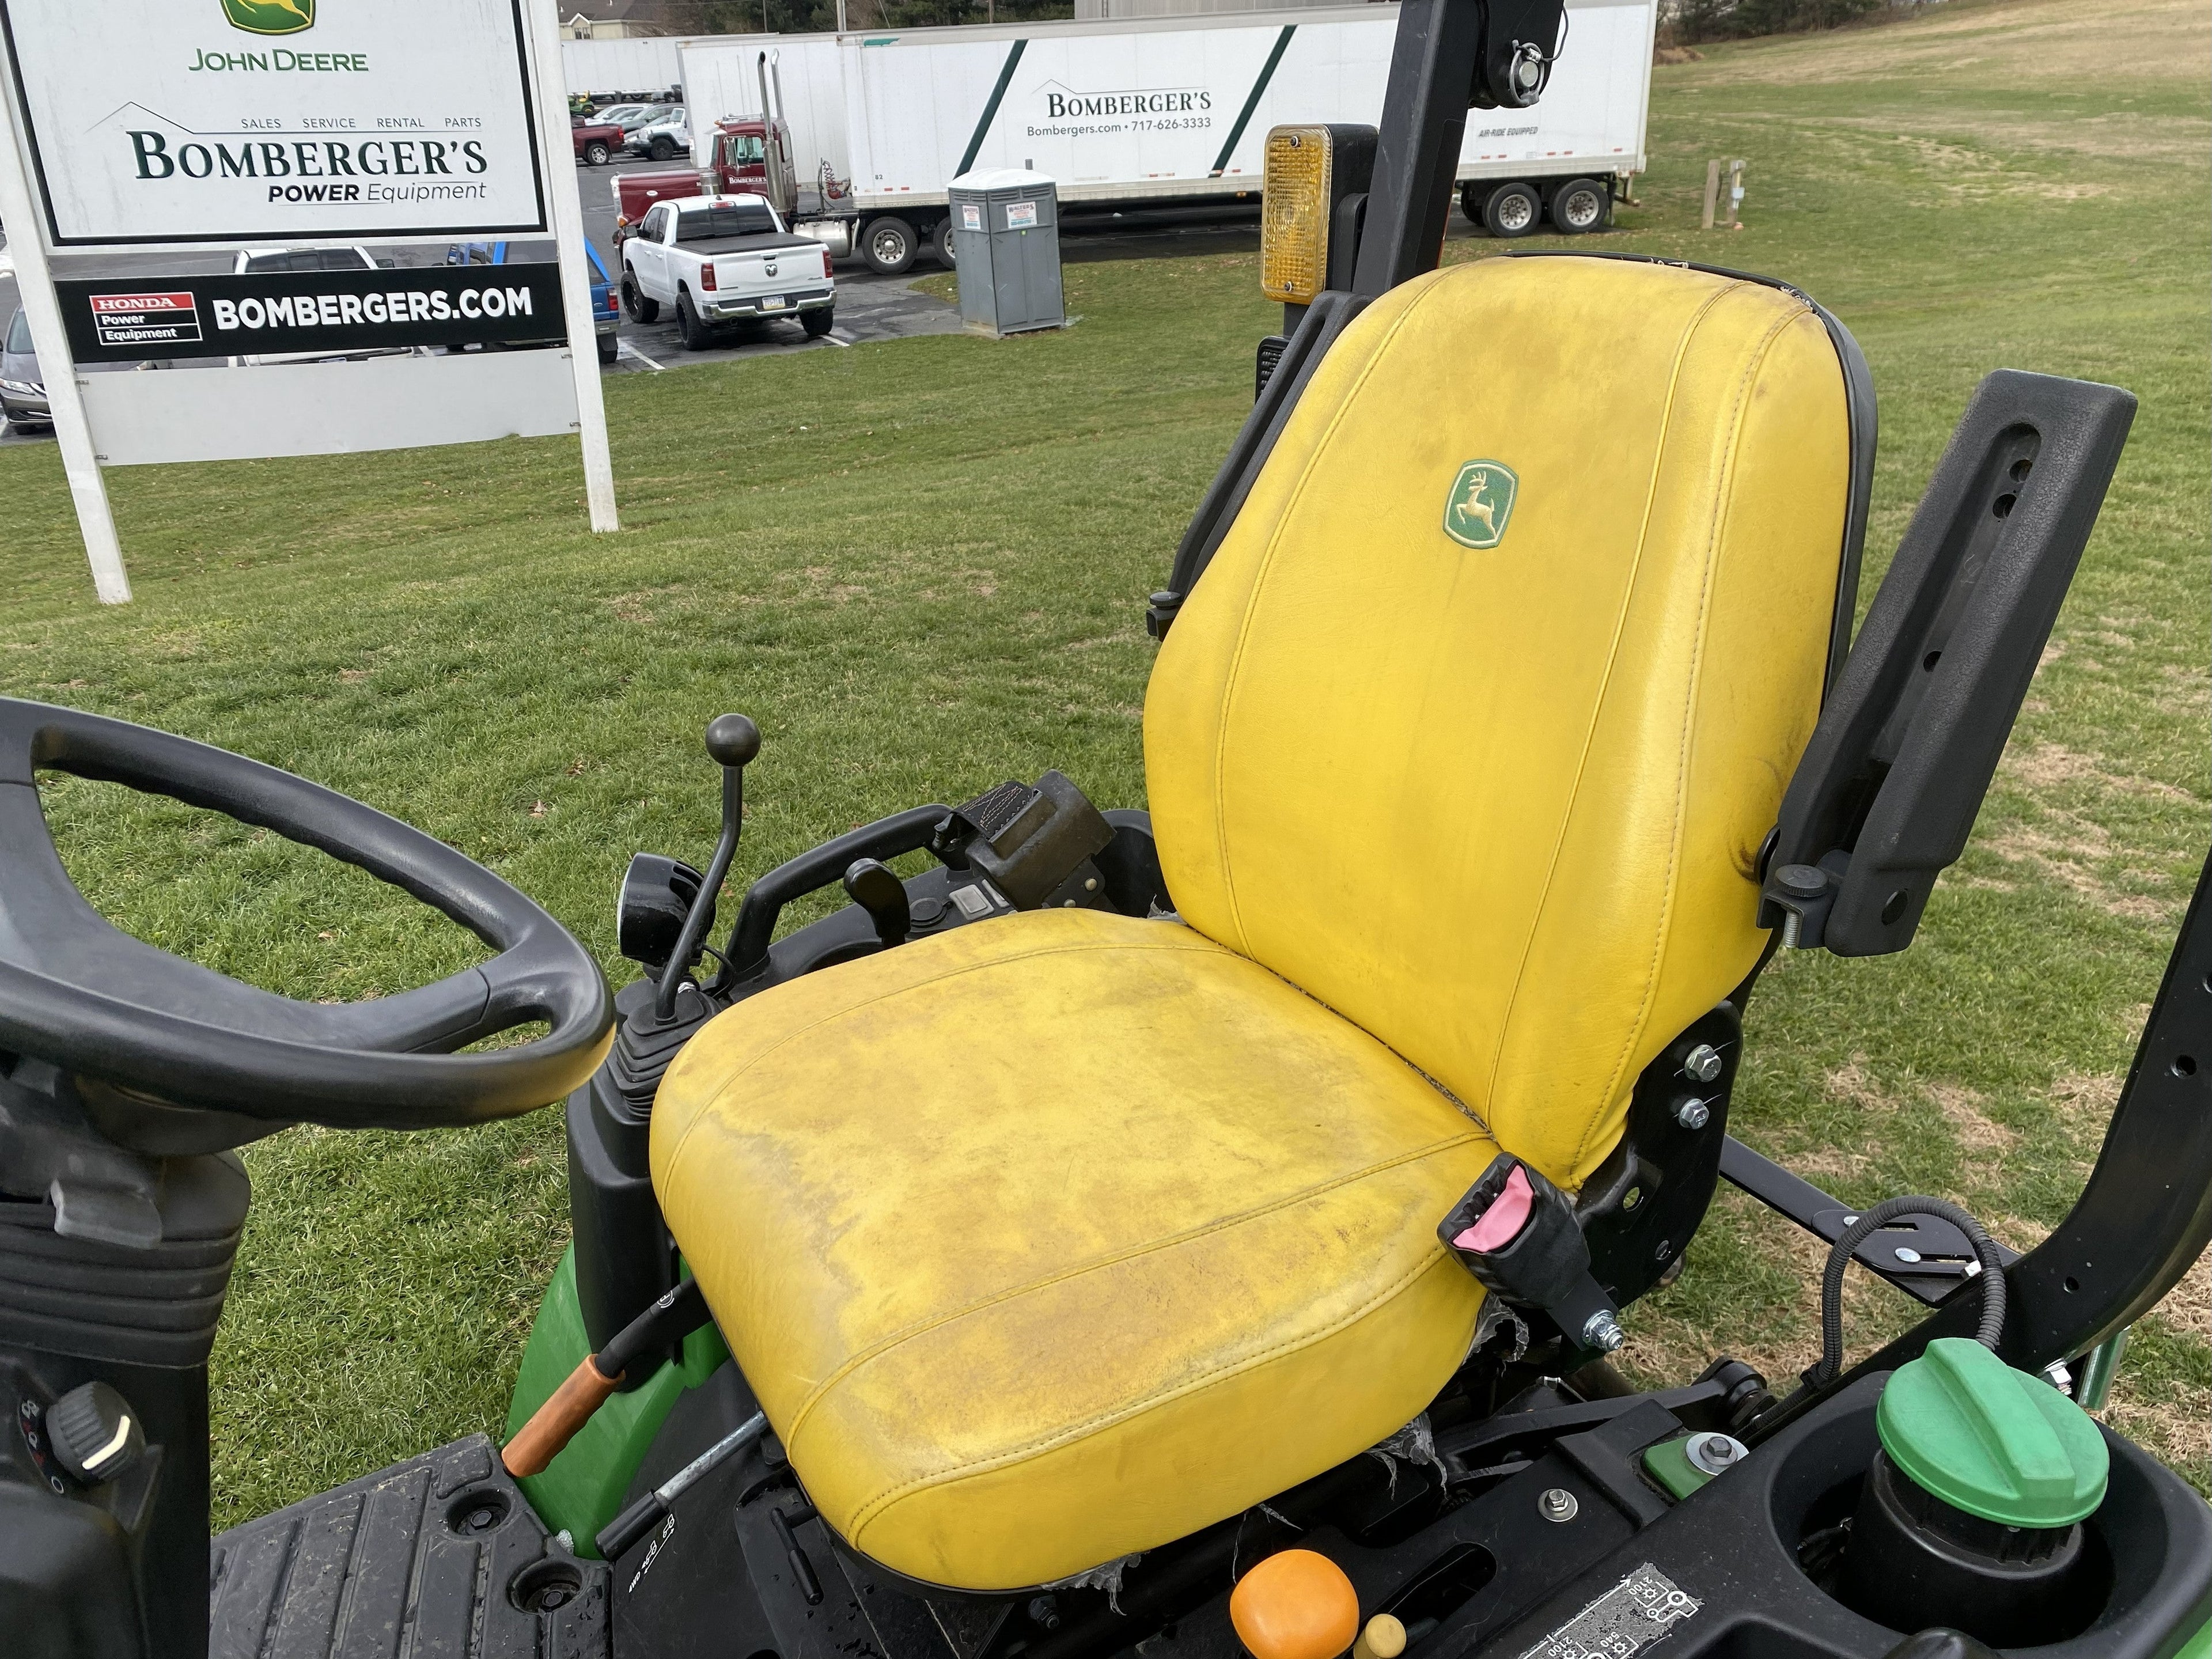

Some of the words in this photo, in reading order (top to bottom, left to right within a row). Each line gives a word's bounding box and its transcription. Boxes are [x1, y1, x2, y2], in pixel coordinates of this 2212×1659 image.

[188, 48, 268, 71] JOHN
[272, 49, 369, 71] DEERE
[1047, 92, 1211, 117] BOMBERGER'S
[241, 119, 281, 128] SALES
[303, 118, 356, 128] SERVICE
[377, 118, 425, 127] RENTAL
[445, 118, 481, 127] PARTS
[1028, 124, 1121, 137] Bombergers.com
[1131, 118, 1211, 131] 717-626-3333
[1479, 128, 1505, 137] AIR-RIDE
[1507, 127, 1537, 135] EQUIPPED
[126, 131, 487, 179] BOMBERGER'S
[268, 184, 359, 202] POWER
[368, 183, 486, 203] Equipment
[97, 298, 177, 309] HONDA
[212, 287, 533, 329] BOMBERGERS.COM
[101, 315, 145, 325] Power
[105, 328, 177, 341] Equipment
[1628, 1576, 1653, 1595] 2100
[1548, 1636, 1573, 1657] 2100
[1600, 1631, 1620, 1648] 540
